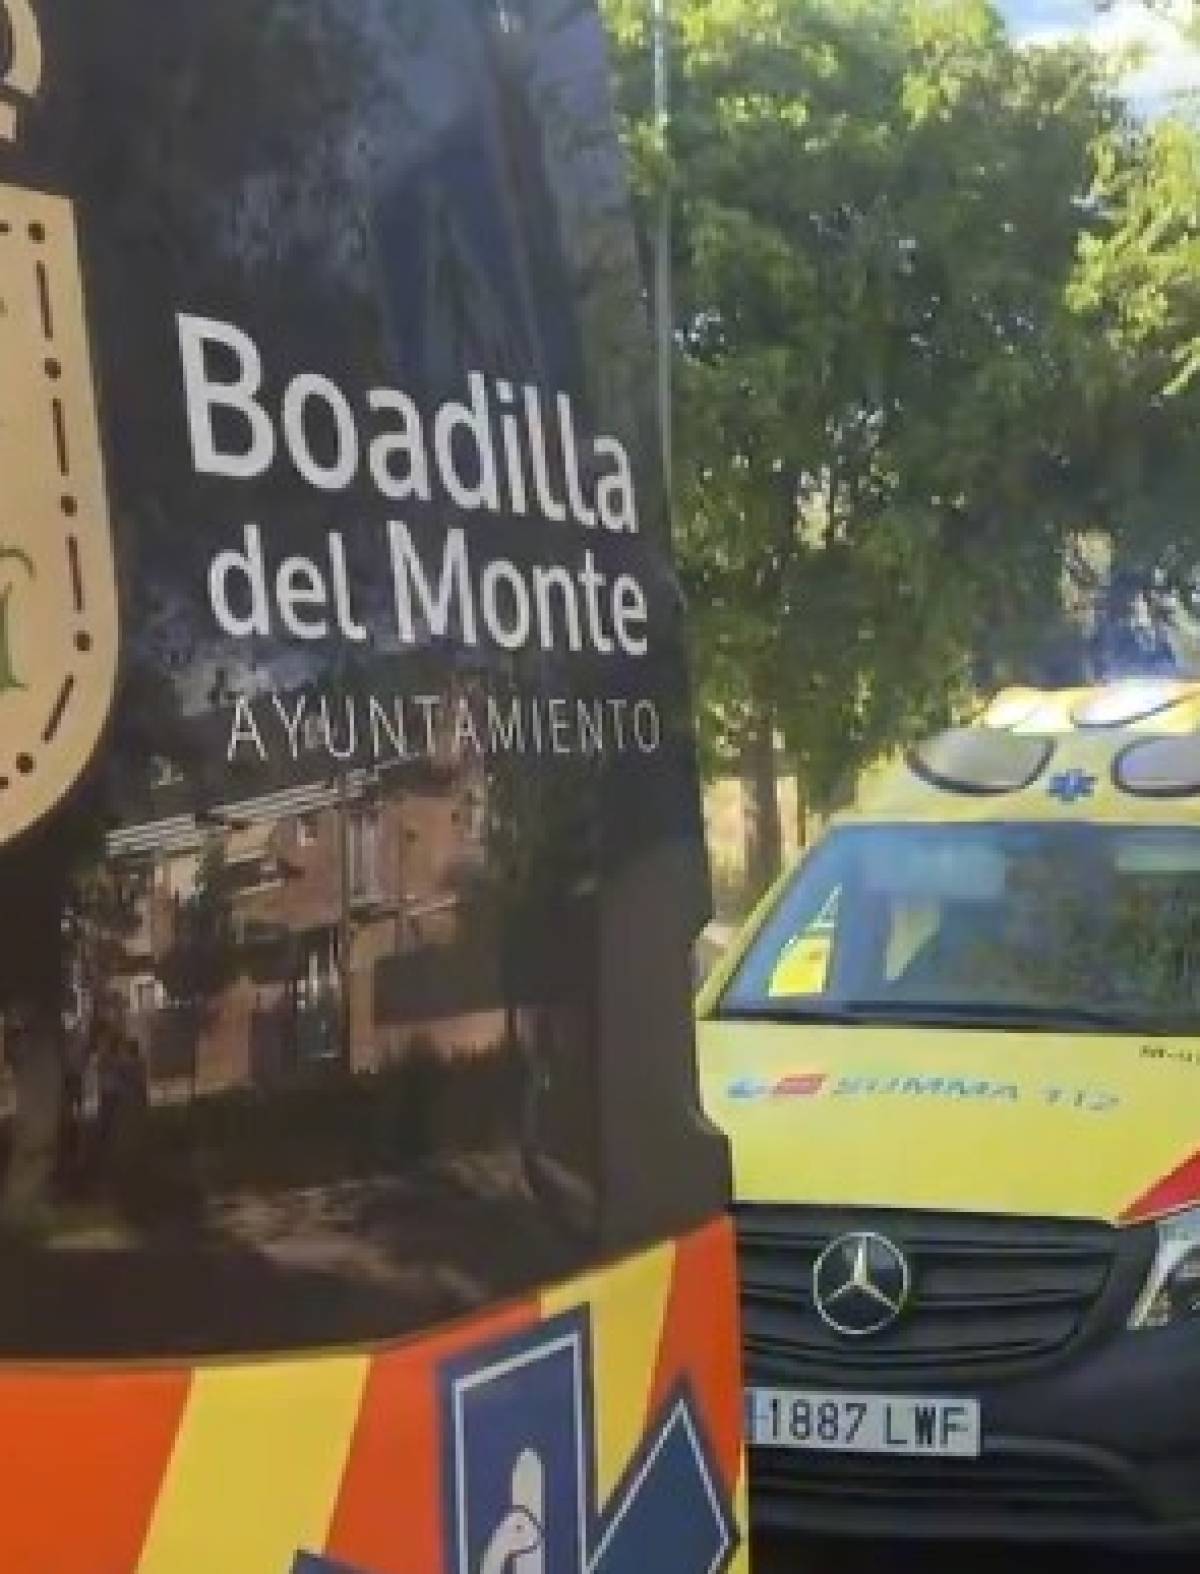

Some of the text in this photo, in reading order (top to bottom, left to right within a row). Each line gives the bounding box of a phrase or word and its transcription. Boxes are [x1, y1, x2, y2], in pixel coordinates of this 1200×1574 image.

[177, 312, 638, 533] Boadilla
[207, 520, 648, 655] del Monte
[227, 696, 661, 761] AYUNTAMIENTO
[769, 1398, 969, 1449] 1887 LWF
